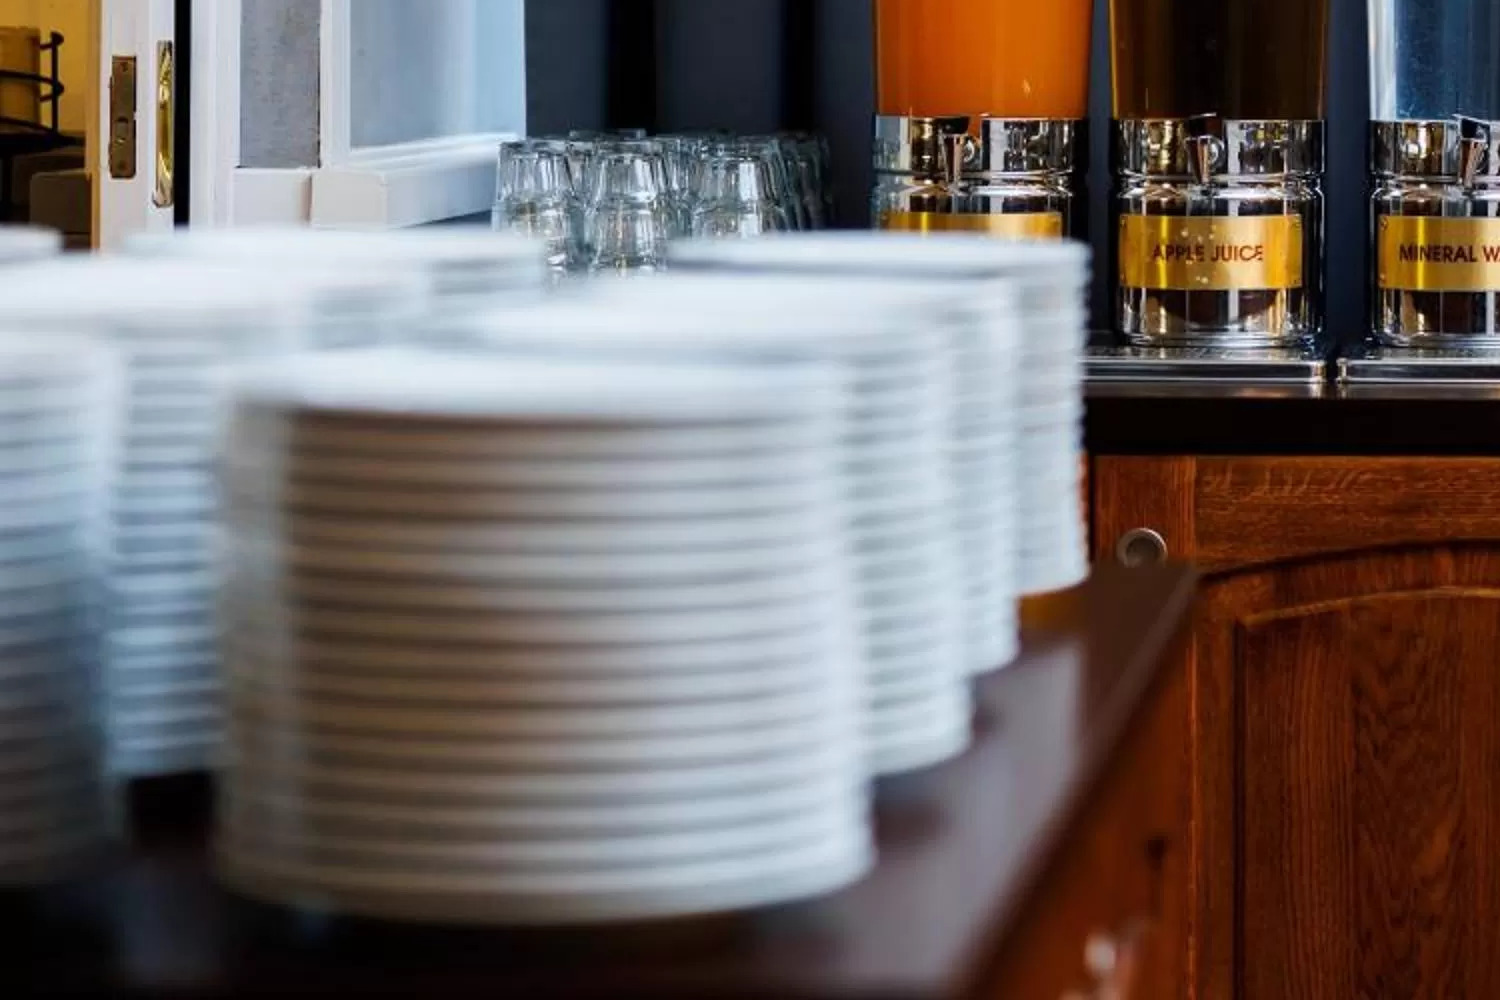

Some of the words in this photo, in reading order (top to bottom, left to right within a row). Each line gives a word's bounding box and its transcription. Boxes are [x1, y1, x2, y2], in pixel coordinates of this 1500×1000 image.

[1152, 244, 1205, 262] APPLE
[1211, 244, 1264, 262] JUICE
[1399, 244, 1477, 263] MINERAL
